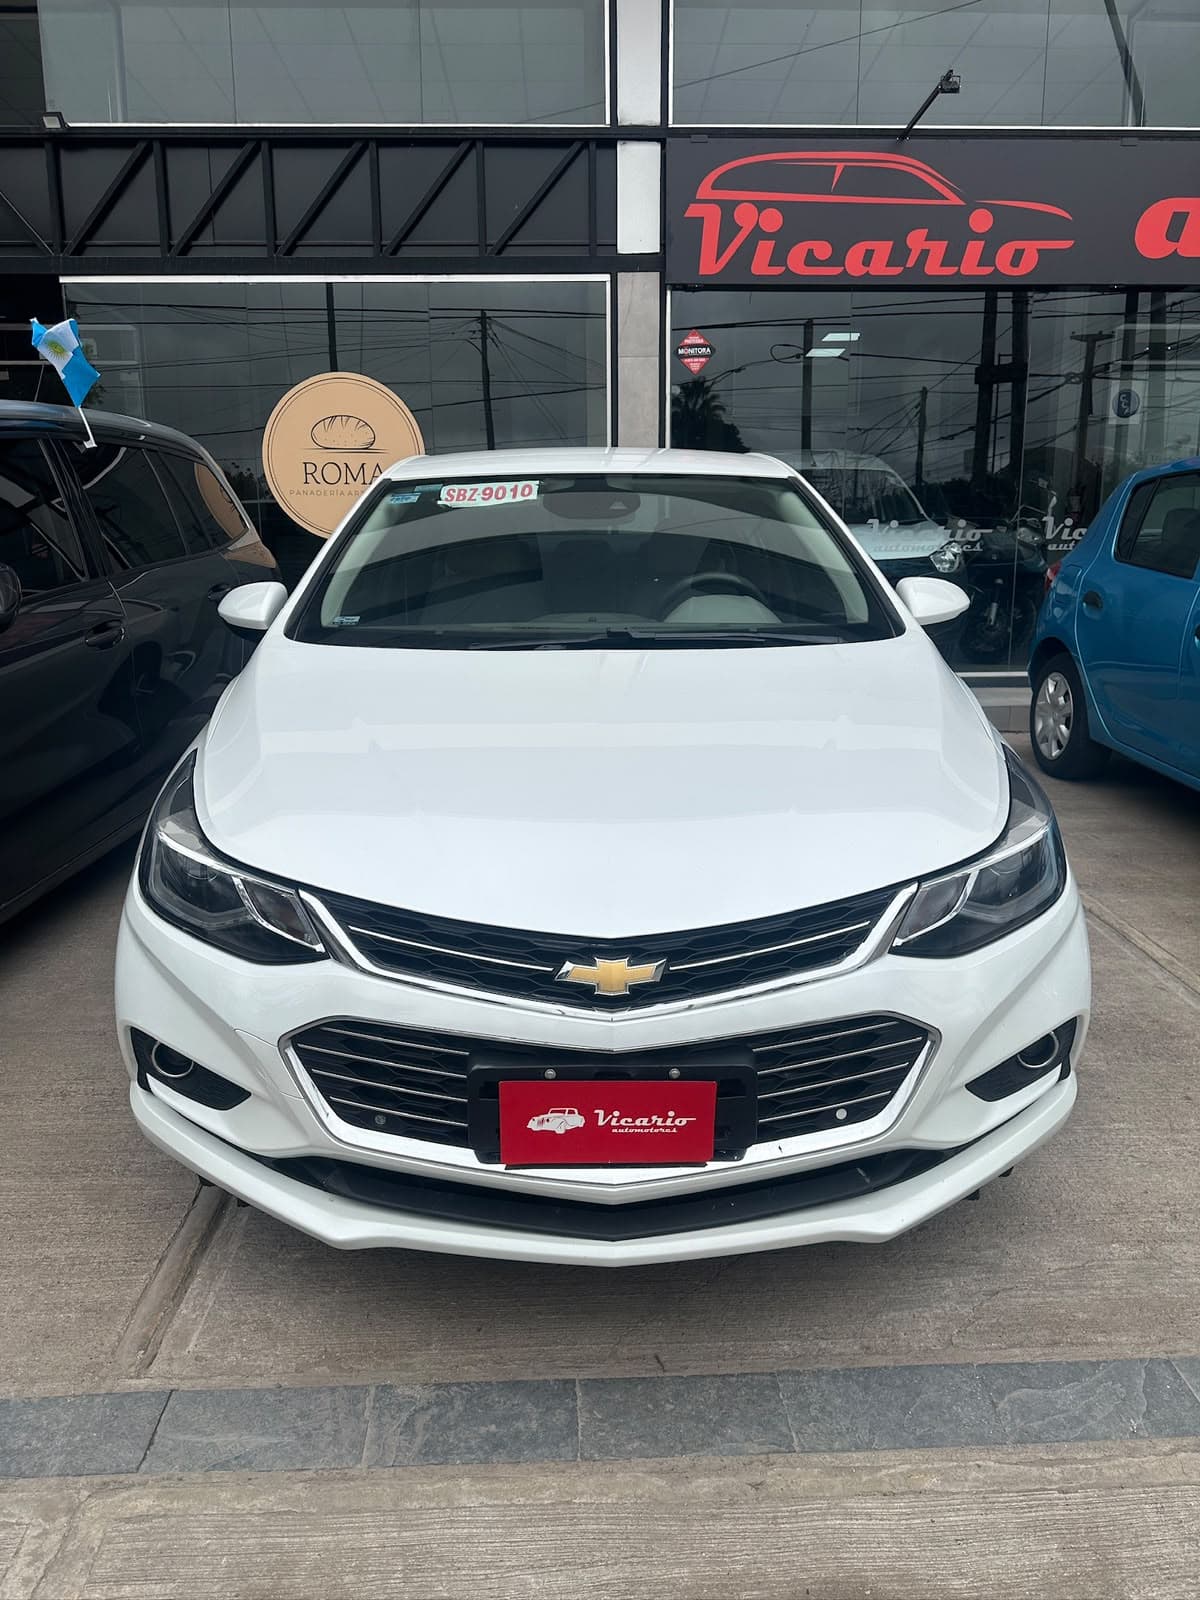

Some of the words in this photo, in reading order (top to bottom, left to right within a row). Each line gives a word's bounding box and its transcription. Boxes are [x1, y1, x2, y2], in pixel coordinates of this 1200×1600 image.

[684, 201, 1075, 277] Vicario
[678, 347, 711, 355] MONITORA
[303, 461, 384, 486] ROMA
[289, 488, 345, 497] PANADERÍA
[594, 1109, 697, 1126] Vicario
